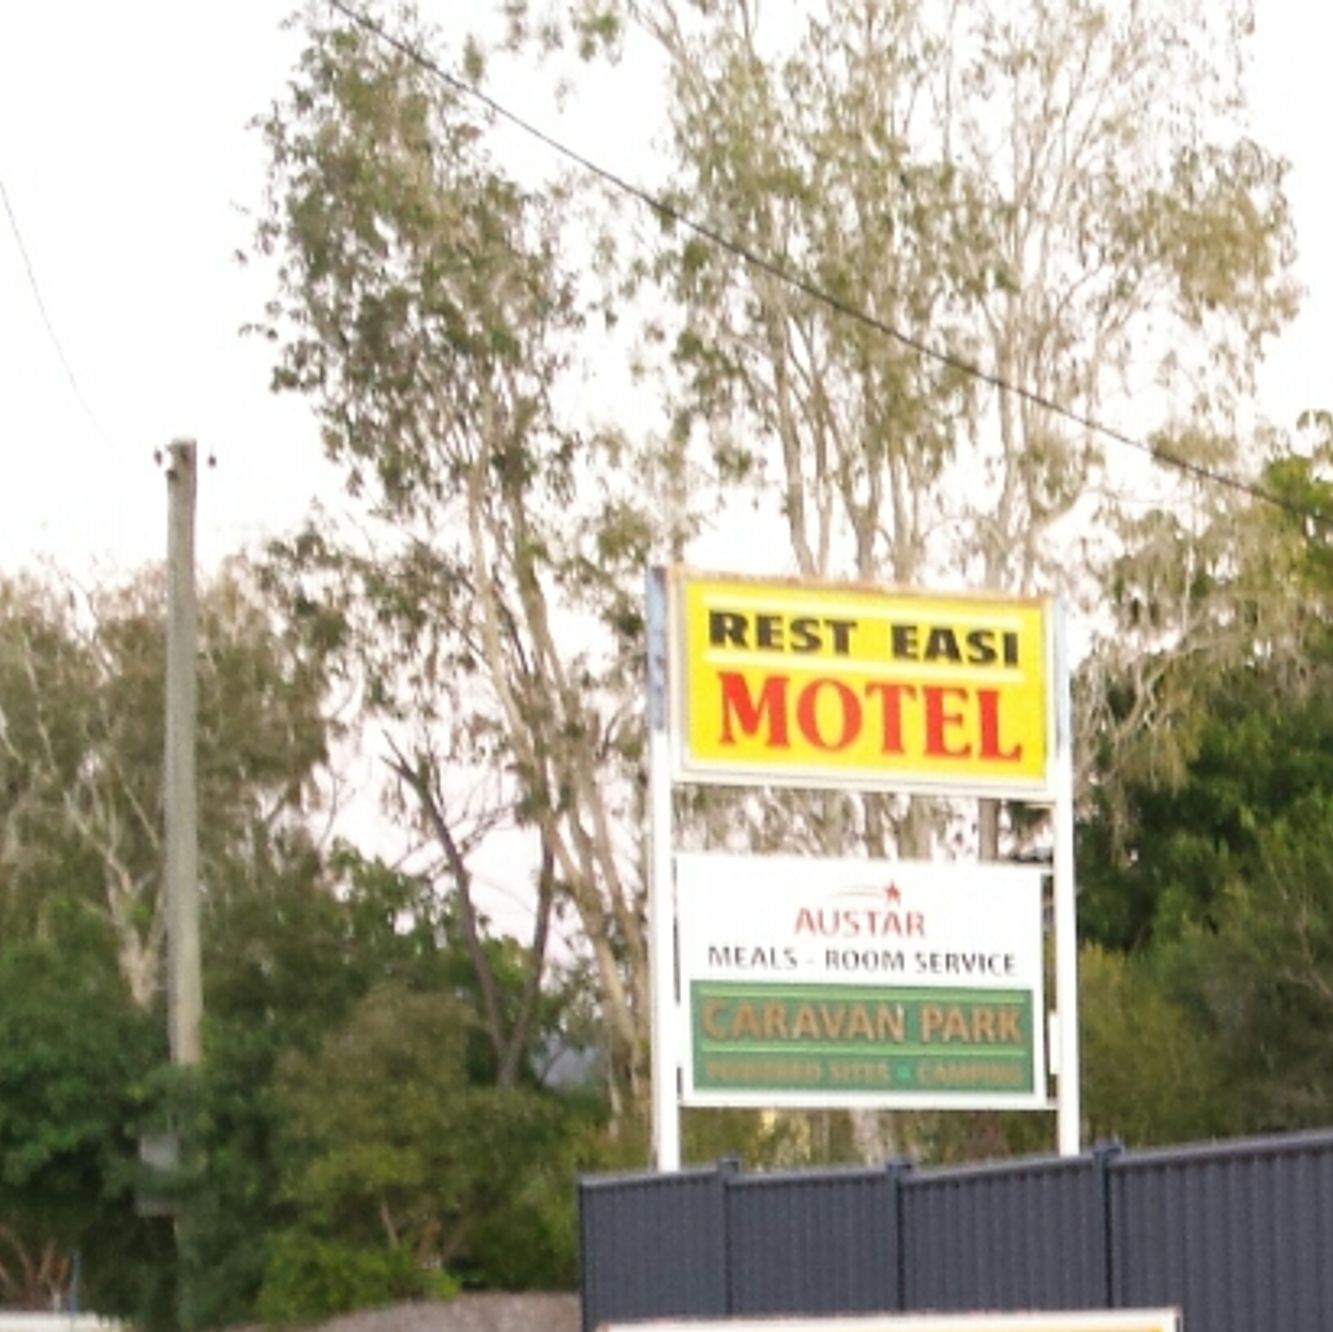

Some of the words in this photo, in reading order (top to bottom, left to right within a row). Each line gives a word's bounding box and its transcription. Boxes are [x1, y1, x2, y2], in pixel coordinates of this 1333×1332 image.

[708, 610, 857, 656] REST
[890, 623, 1019, 667] EASI
[716, 670, 1023, 763] MOTEL
[794, 907, 927, 939] AUSTAR
[707, 945, 799, 970] MEALS
[824, 950, 905, 972] ROOM
[914, 952, 1018, 976] SERVICE
[702, 998, 904, 1042] CARAVAN
[918, 1004, 1024, 1045] PARK
